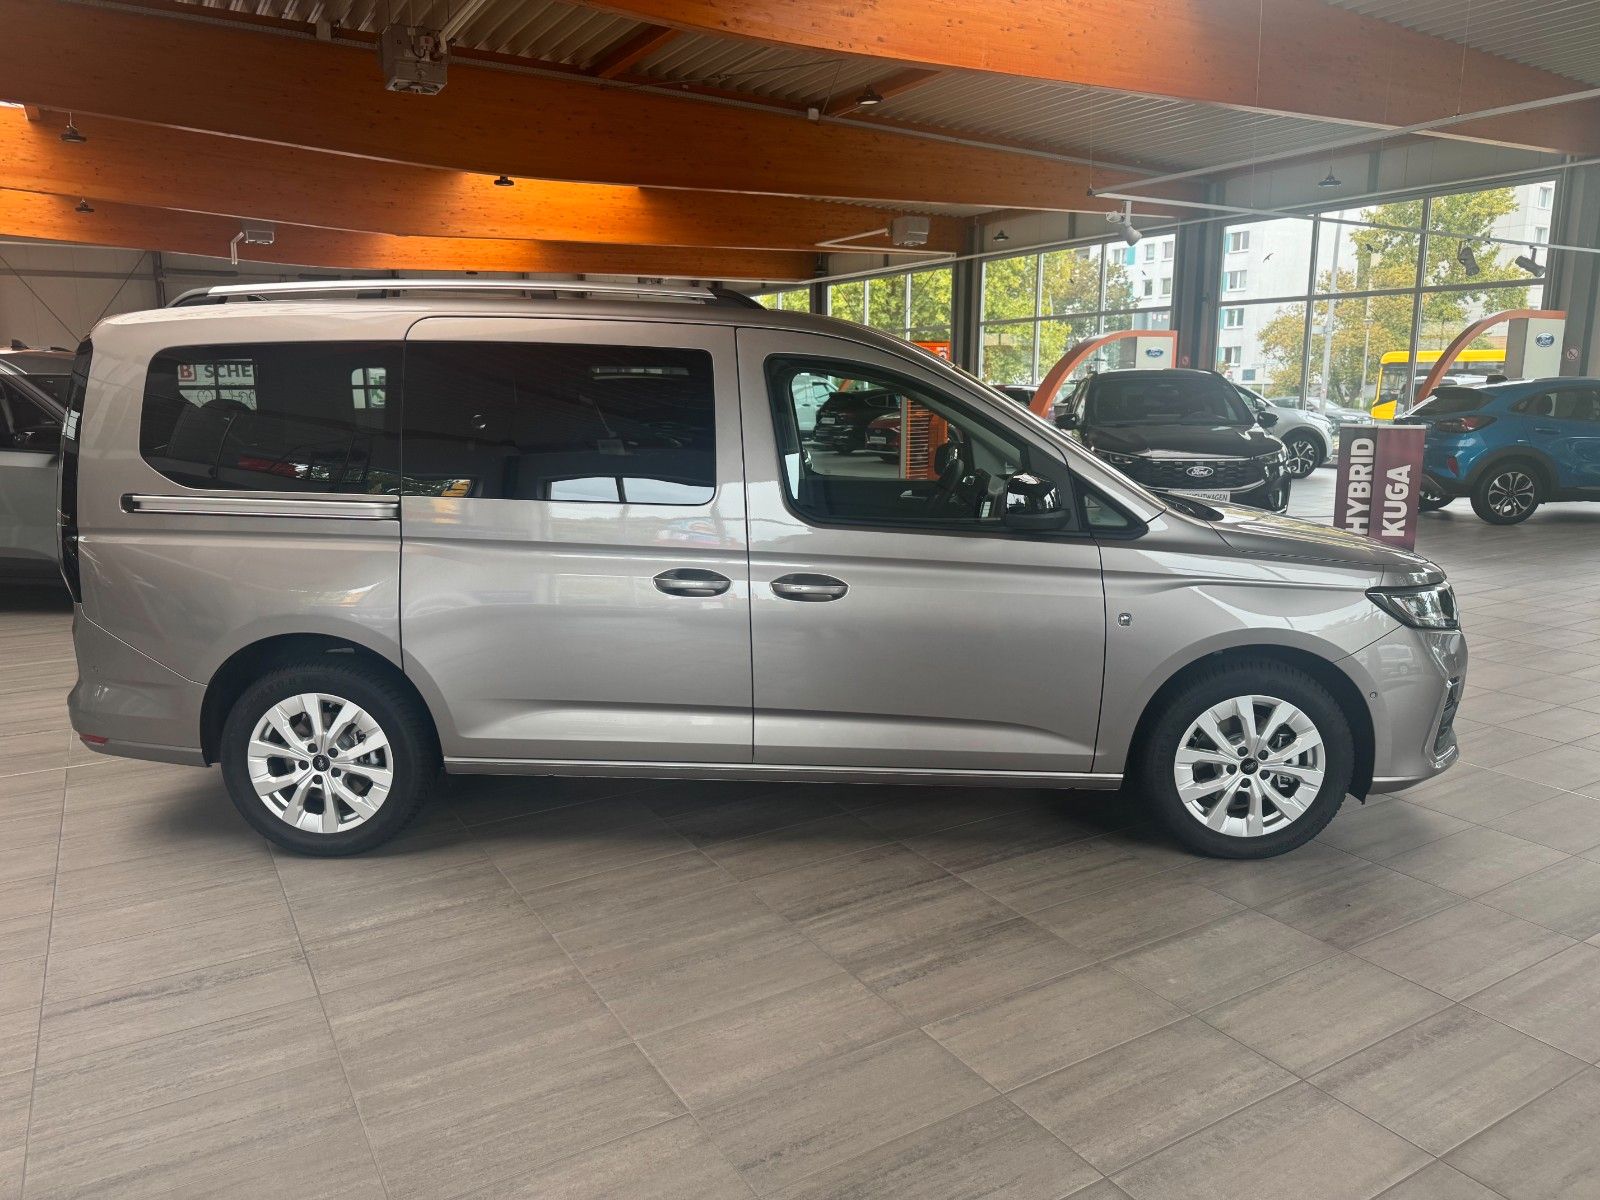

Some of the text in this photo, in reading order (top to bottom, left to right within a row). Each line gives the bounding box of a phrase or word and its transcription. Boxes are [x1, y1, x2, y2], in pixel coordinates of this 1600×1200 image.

[1190, 467, 1210, 476] Ford
[1345, 438, 1374, 535] HYBRID
[1381, 464, 1411, 536] KUGA
